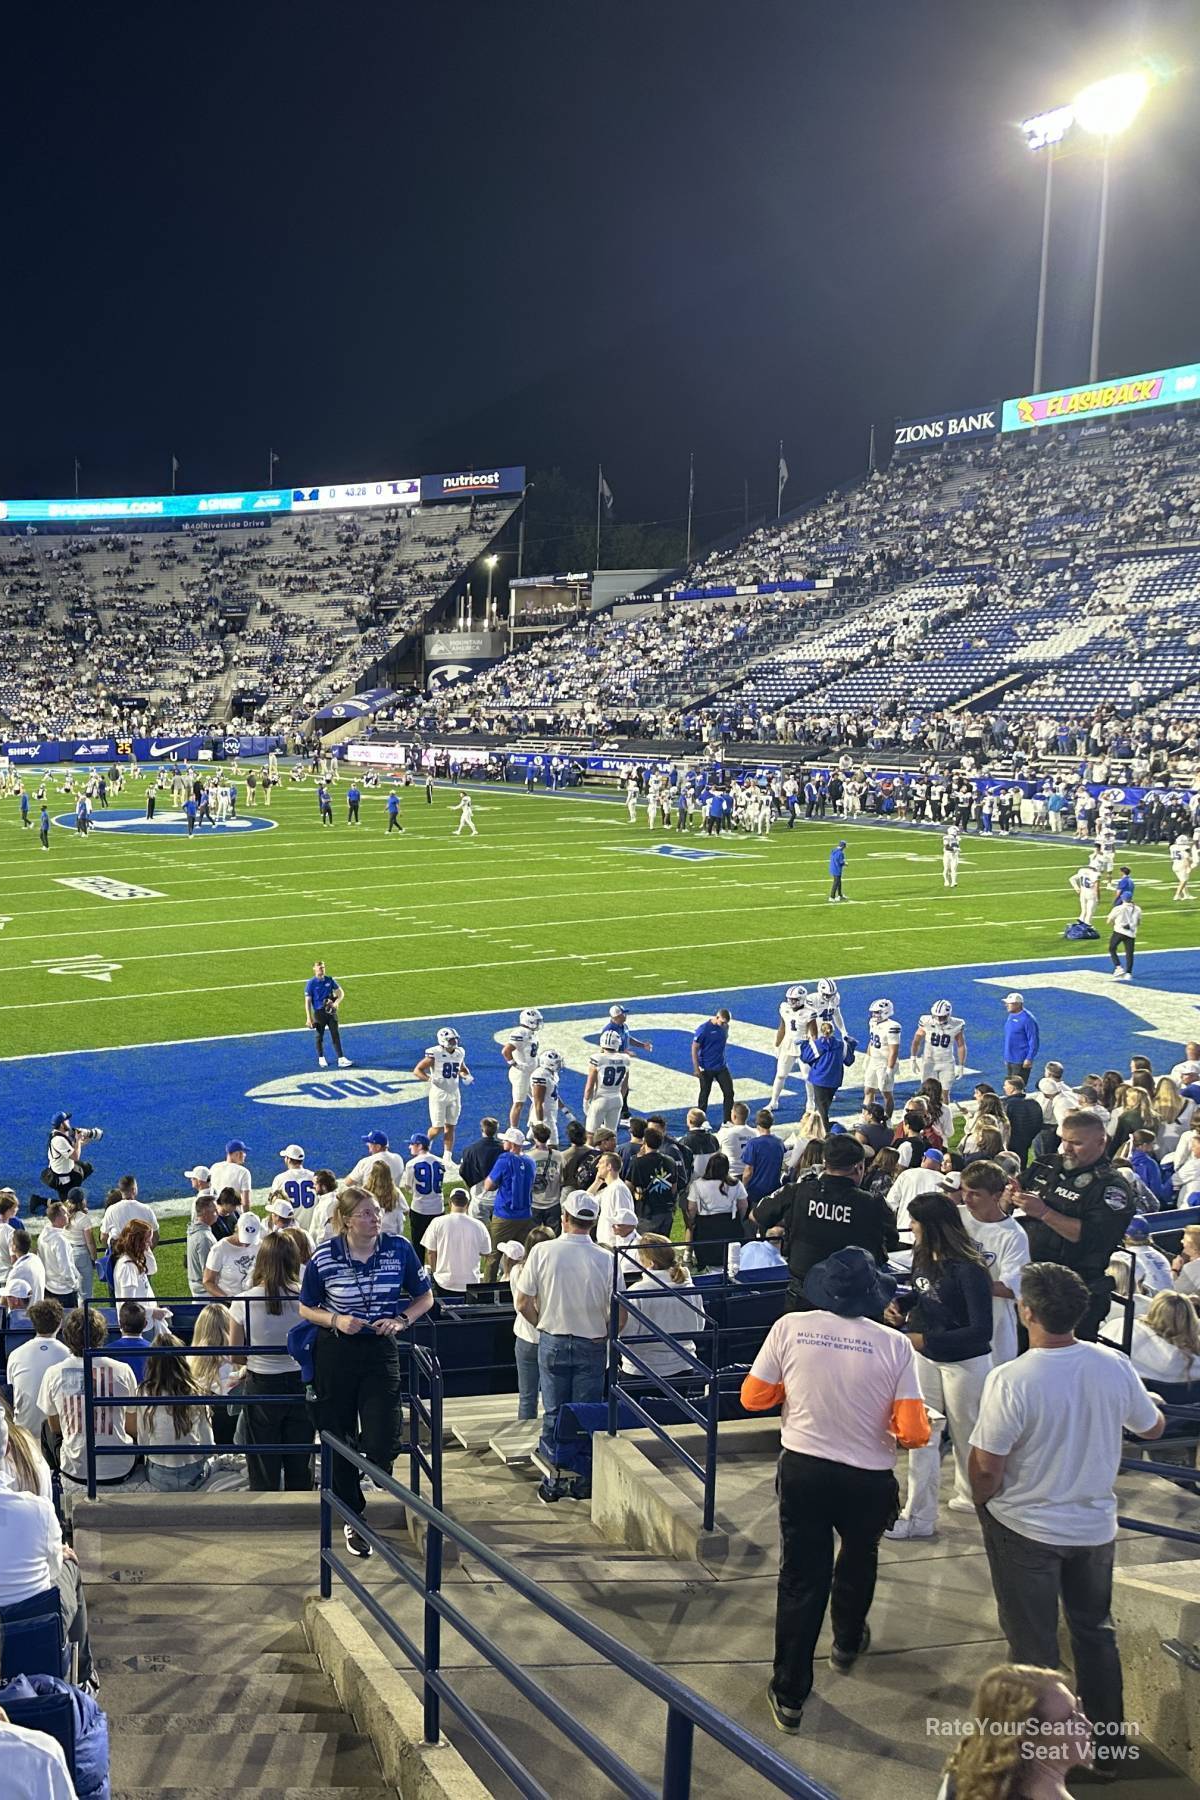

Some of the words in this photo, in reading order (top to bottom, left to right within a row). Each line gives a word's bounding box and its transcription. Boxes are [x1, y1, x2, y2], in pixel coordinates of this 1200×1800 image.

[1045, 378, 1158, 417] FLASHBACK
[894, 421, 944, 445] ZIONS
[947, 411, 997, 435] BANK
[443, 472, 501, 489] nutricost
[243, 520, 265, 528] Drive
[117, 742, 132, 754] 25
[442, 1062, 460, 1079] 85
[602, 1066, 627, 1087] 87
[284, 1180, 316, 1209] 96
[1054, 1186, 1081, 1201] POLICE
[807, 1200, 852, 1224] POLICE
[796, 1330, 874, 1349] MULTICULTURAL
[796, 1337, 832, 1351] STUDENT
[833, 1341, 874, 1355] SERVICES
[143, 1655, 171, 1664] SEC
